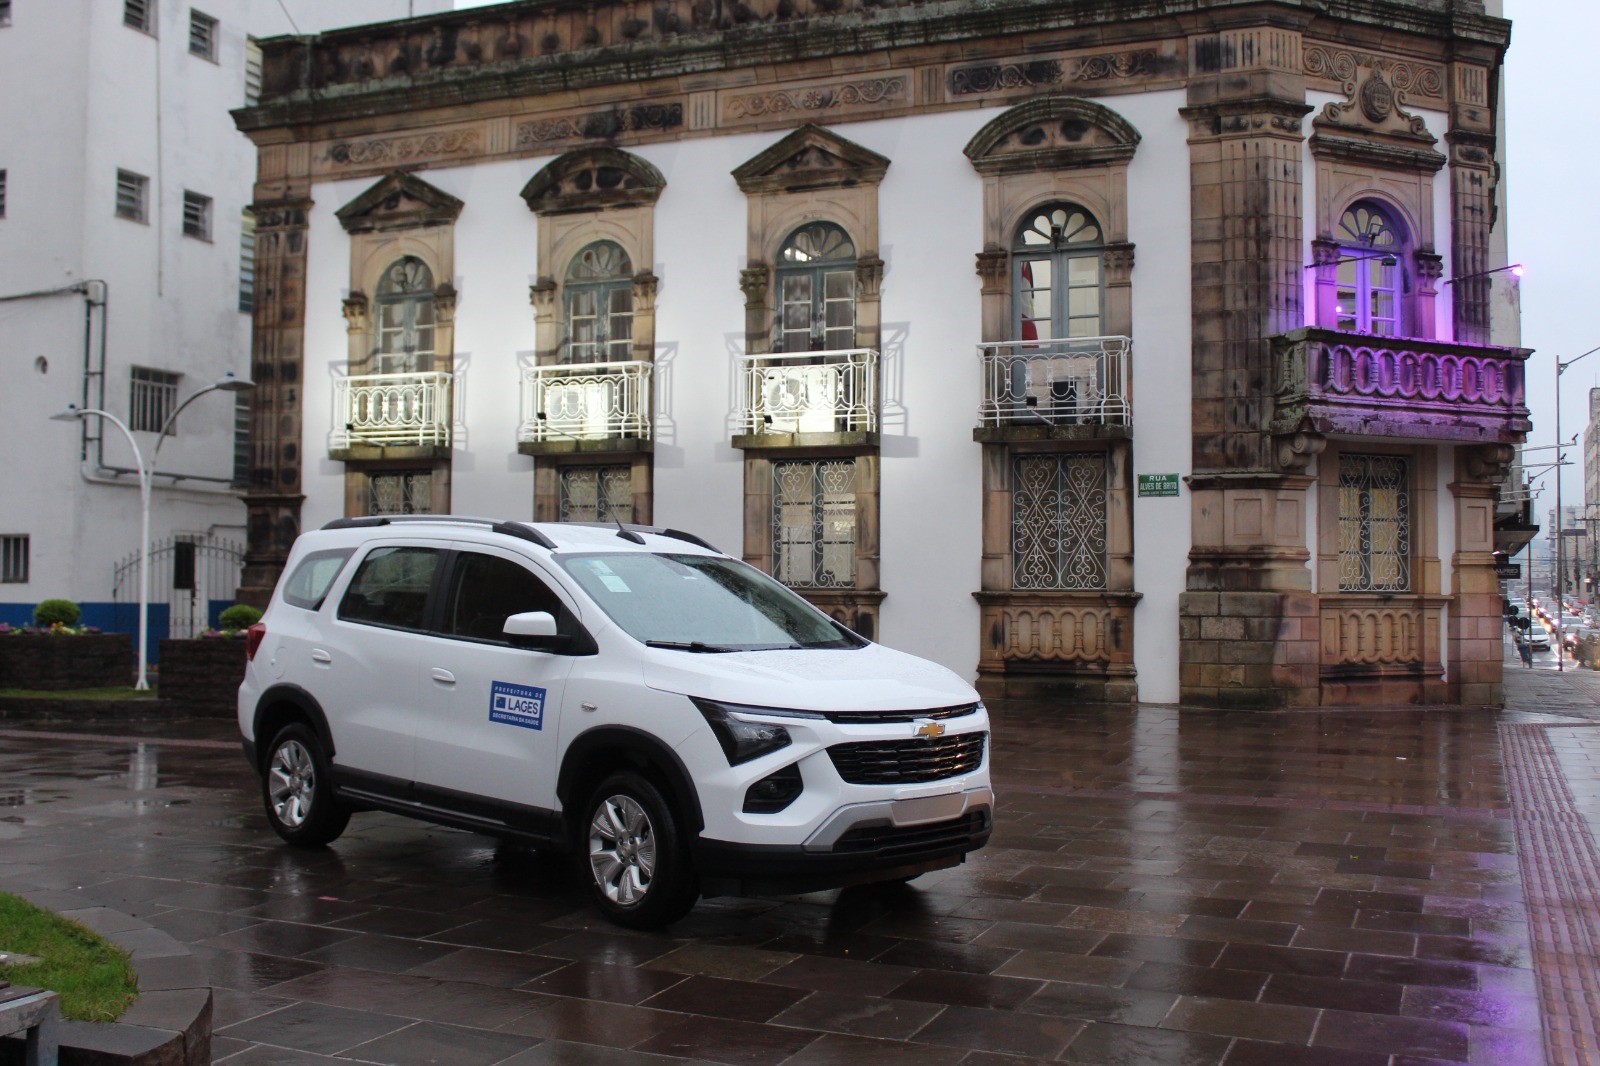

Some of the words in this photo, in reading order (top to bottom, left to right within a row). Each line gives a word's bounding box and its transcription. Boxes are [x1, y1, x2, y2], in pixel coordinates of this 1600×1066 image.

[1140, 482, 1154, 490] ALVES
[1156, 482, 1162, 490] DE
[1163, 482, 1177, 490] BRITO
[495, 686, 532, 697] PREFEITURA
[508, 697, 539, 715] LAGES
[492, 712, 518, 721] SECRETARIA
